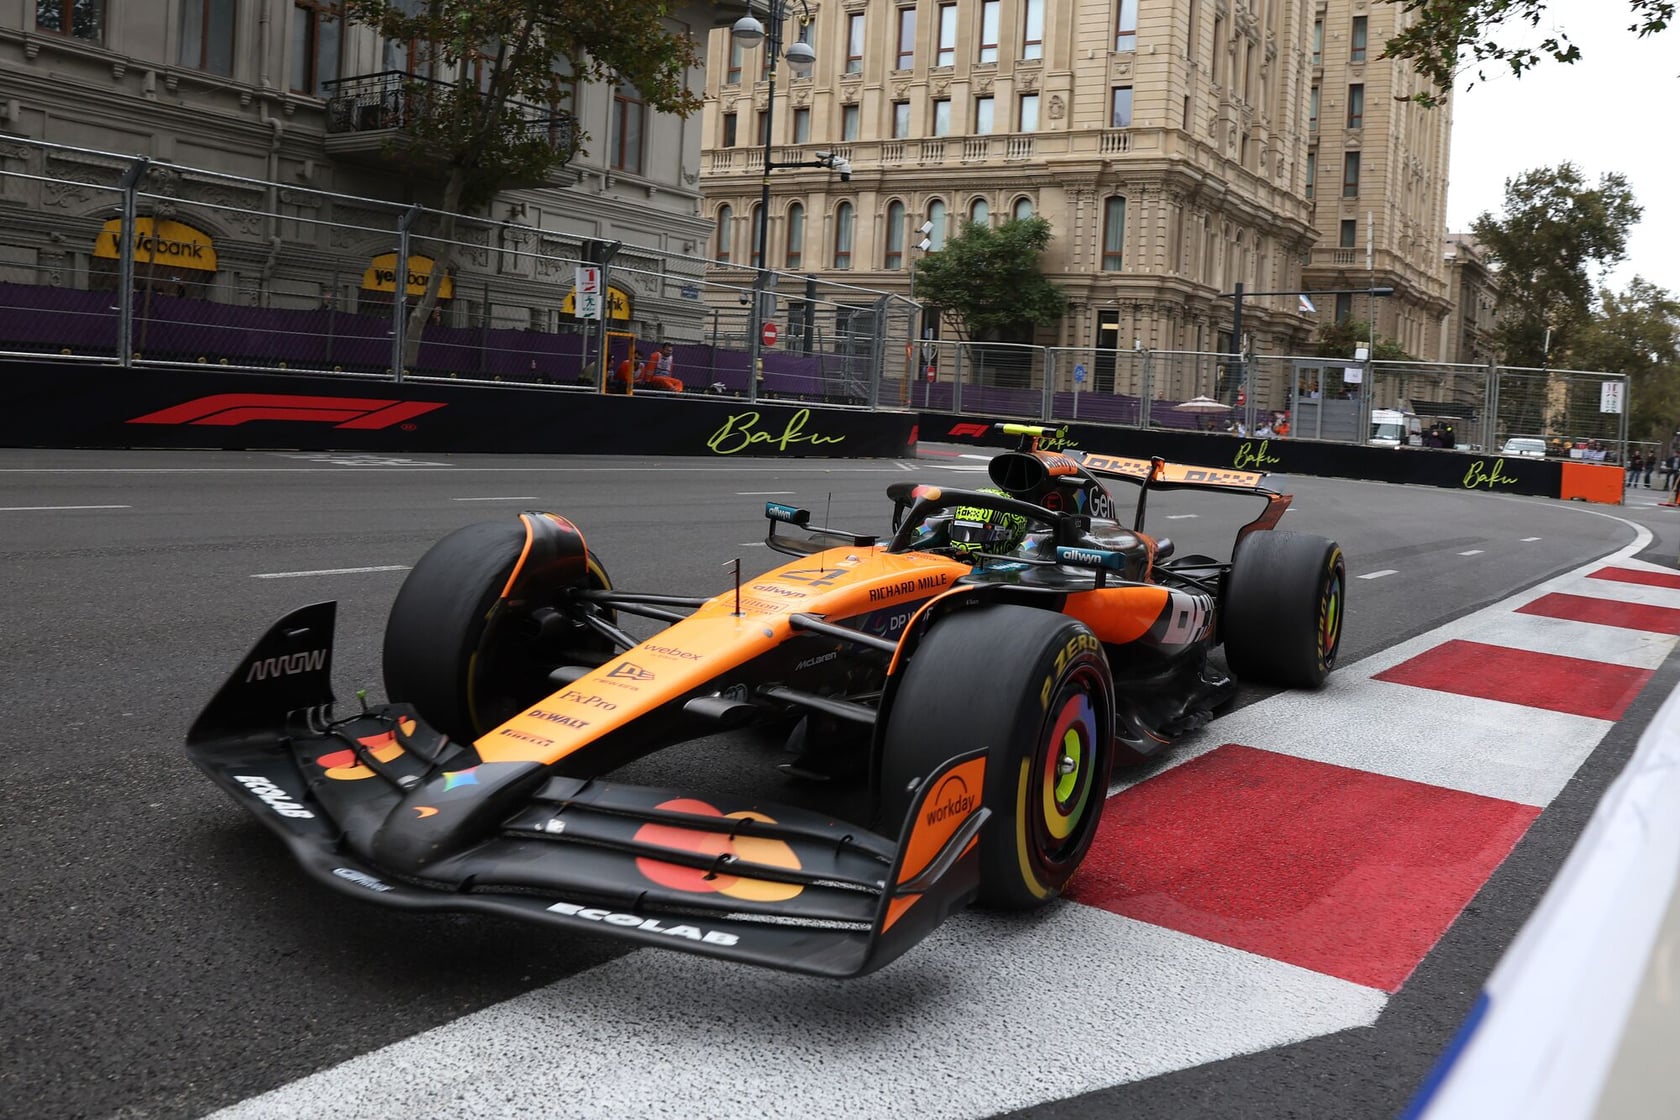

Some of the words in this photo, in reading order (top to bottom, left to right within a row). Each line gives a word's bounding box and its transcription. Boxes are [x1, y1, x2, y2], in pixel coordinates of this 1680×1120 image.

[112, 232, 202, 258] ylobank
[707, 408, 846, 454] Baku
[1234, 440, 1280, 469] Baku
[1463, 458, 1518, 489] Baku
[1062, 548, 1102, 564] allwyn
[753, 585, 807, 598] allwyn
[778, 568, 850, 586] 4
[868, 580, 915, 602] RICHARD
[917, 573, 948, 591] MILLE
[889, 613, 905, 631] DP
[246, 648, 327, 683] ARROW
[643, 643, 704, 661] webex
[794, 650, 837, 671] McLaren
[1054, 634, 1099, 677] ZERO
[559, 690, 618, 711] FxPro
[233, 775, 316, 819] ECOLAB
[926, 795, 975, 827] workday
[546, 902, 741, 946] ECOLAB
